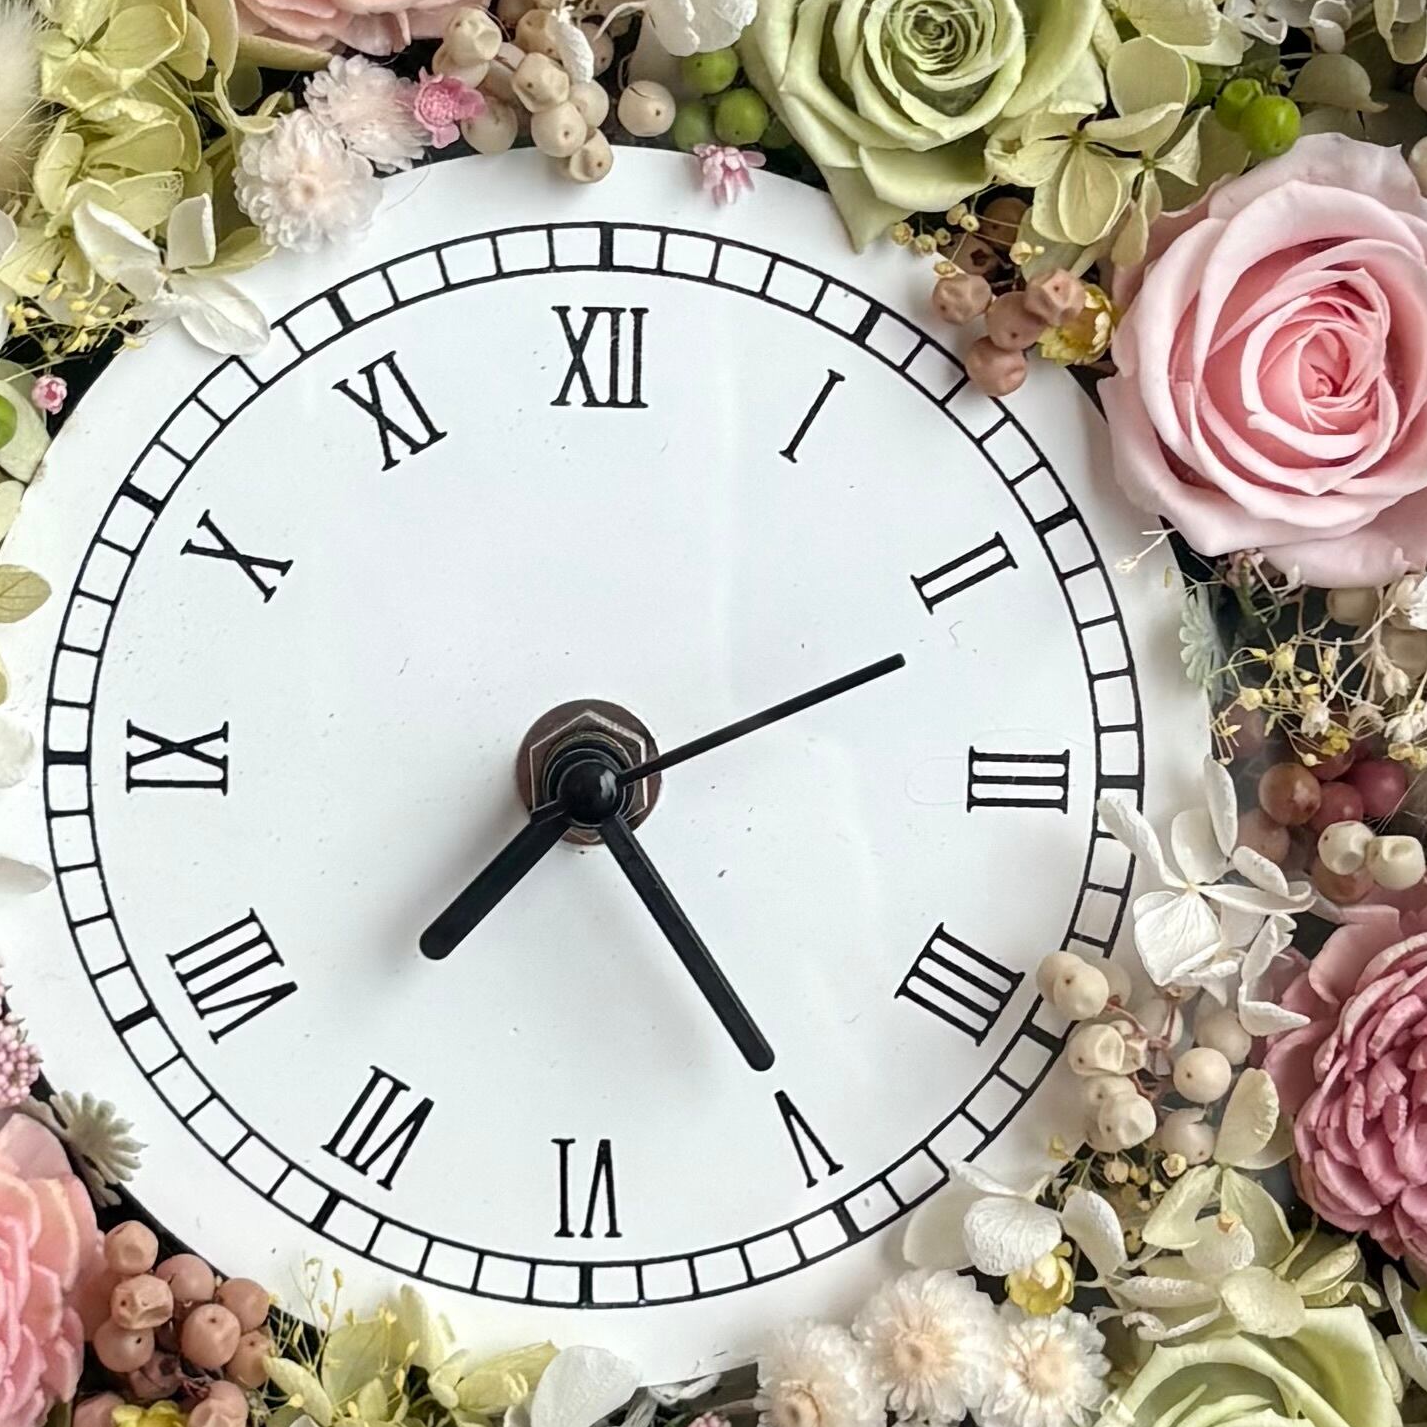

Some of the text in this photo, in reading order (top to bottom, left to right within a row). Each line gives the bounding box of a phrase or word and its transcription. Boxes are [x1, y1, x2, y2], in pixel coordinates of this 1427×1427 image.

[551, 306, 648, 408] XII
[332, 351, 447, 471] XI
[779, 369, 845, 463] I
[181, 510, 293, 603] X
[911, 532, 1018, 614] II
[126, 720, 228, 796] IX
[967, 746, 1070, 814] III
[166, 908, 297, 1044] VIII
[894, 922, 1025, 1047] IIII
[321, 1066, 434, 1190] VII
[775, 1091, 843, 1188] V
[552, 1139, 621, 1238] VI
